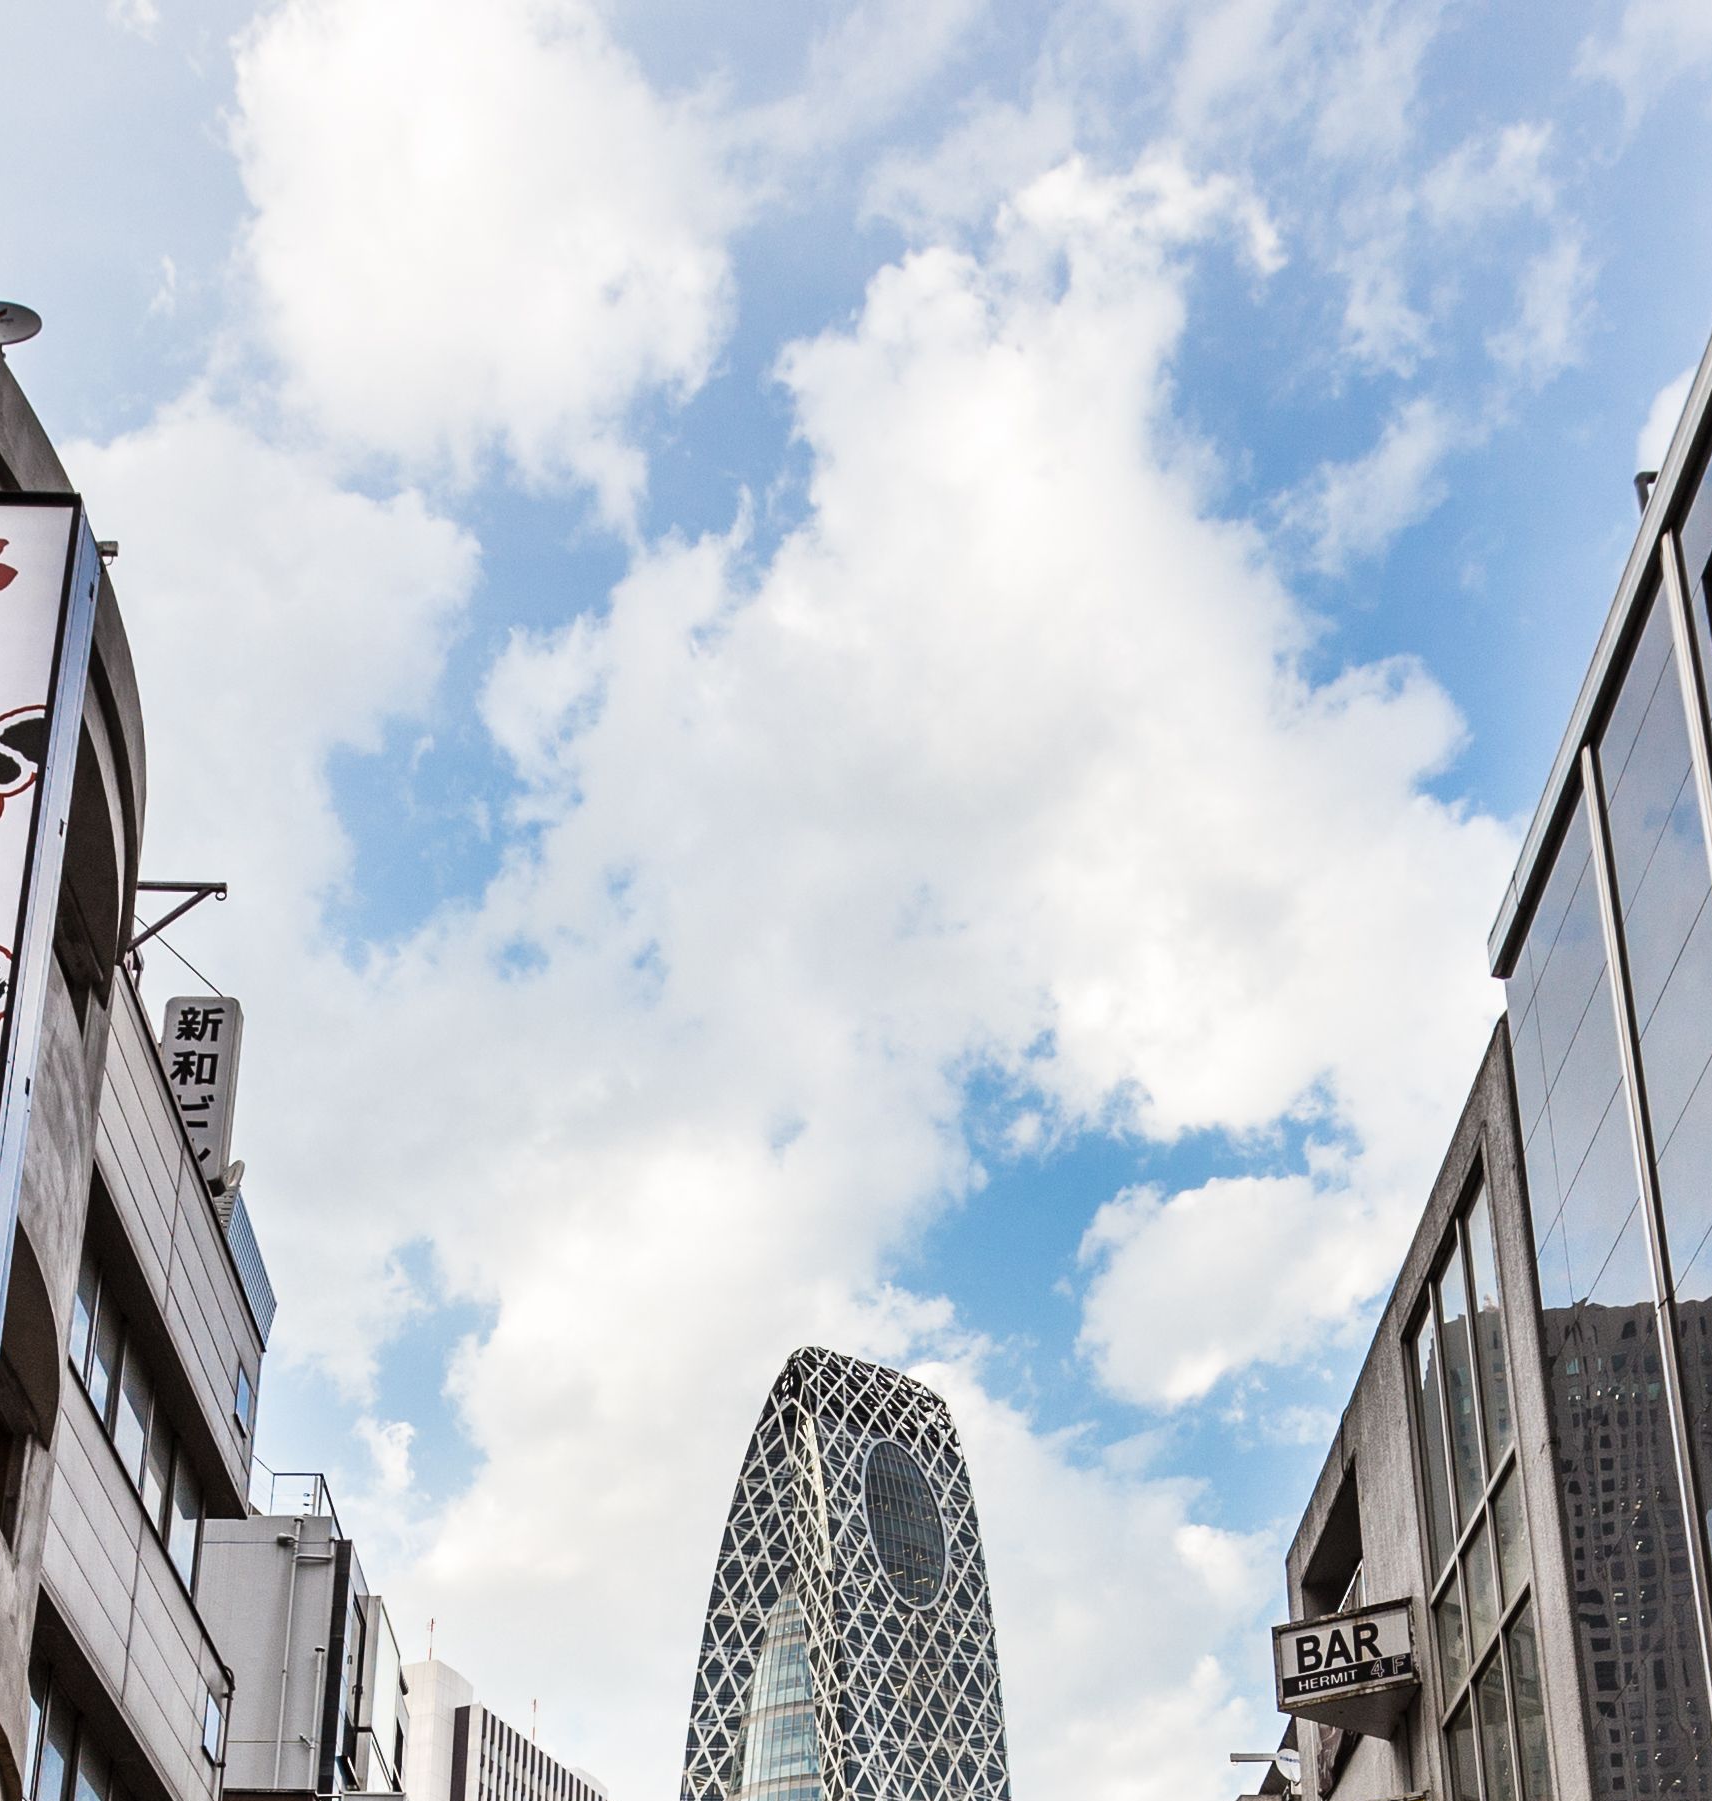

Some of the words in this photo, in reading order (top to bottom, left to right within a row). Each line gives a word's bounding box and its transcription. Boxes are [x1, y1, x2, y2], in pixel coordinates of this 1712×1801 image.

[1296, 1621, 1384, 1677] BAR
[1297, 1668, 1359, 1693] HERMIT
[1370, 1654, 1407, 1679] 4F
